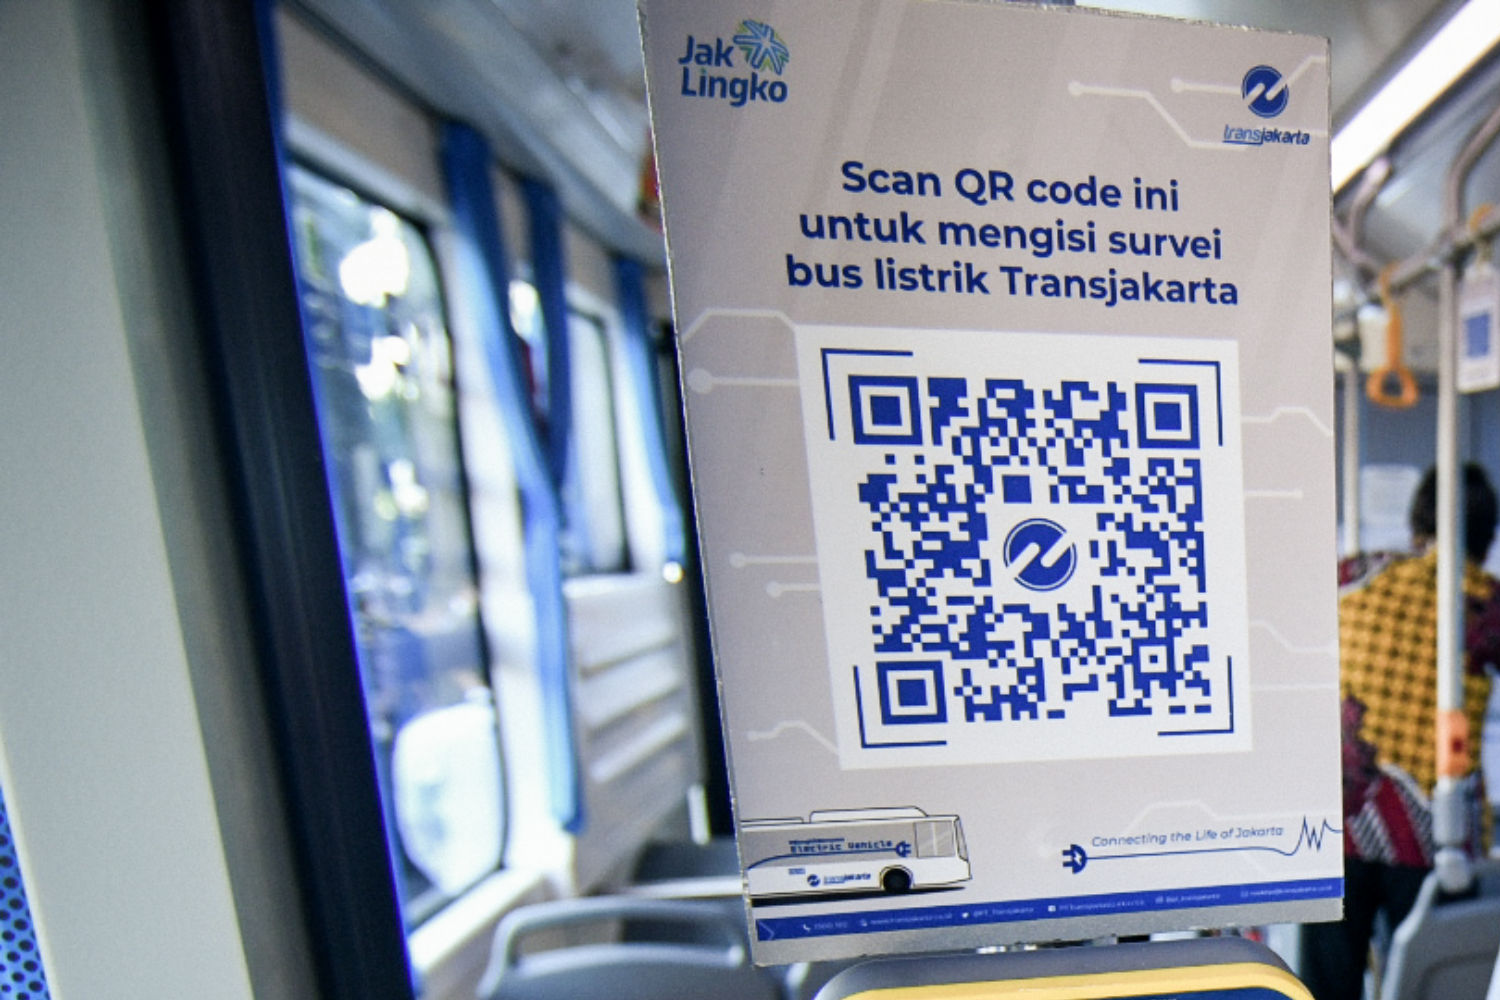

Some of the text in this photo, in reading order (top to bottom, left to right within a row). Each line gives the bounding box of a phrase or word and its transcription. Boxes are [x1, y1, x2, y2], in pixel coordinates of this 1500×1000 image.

[678, 34, 734, 67] Jak
[681, 66, 788, 107] Lingko
[1222, 123, 1311, 147] transjakarta
[841, 160, 1179, 212] Scan QR code ini
[799, 210, 1223, 260] untuk mengisi survei
[787, 254, 1239, 308] bus listrik Transjakarta
[1091, 825, 1285, 848] Connecting the Life of Jakarta
